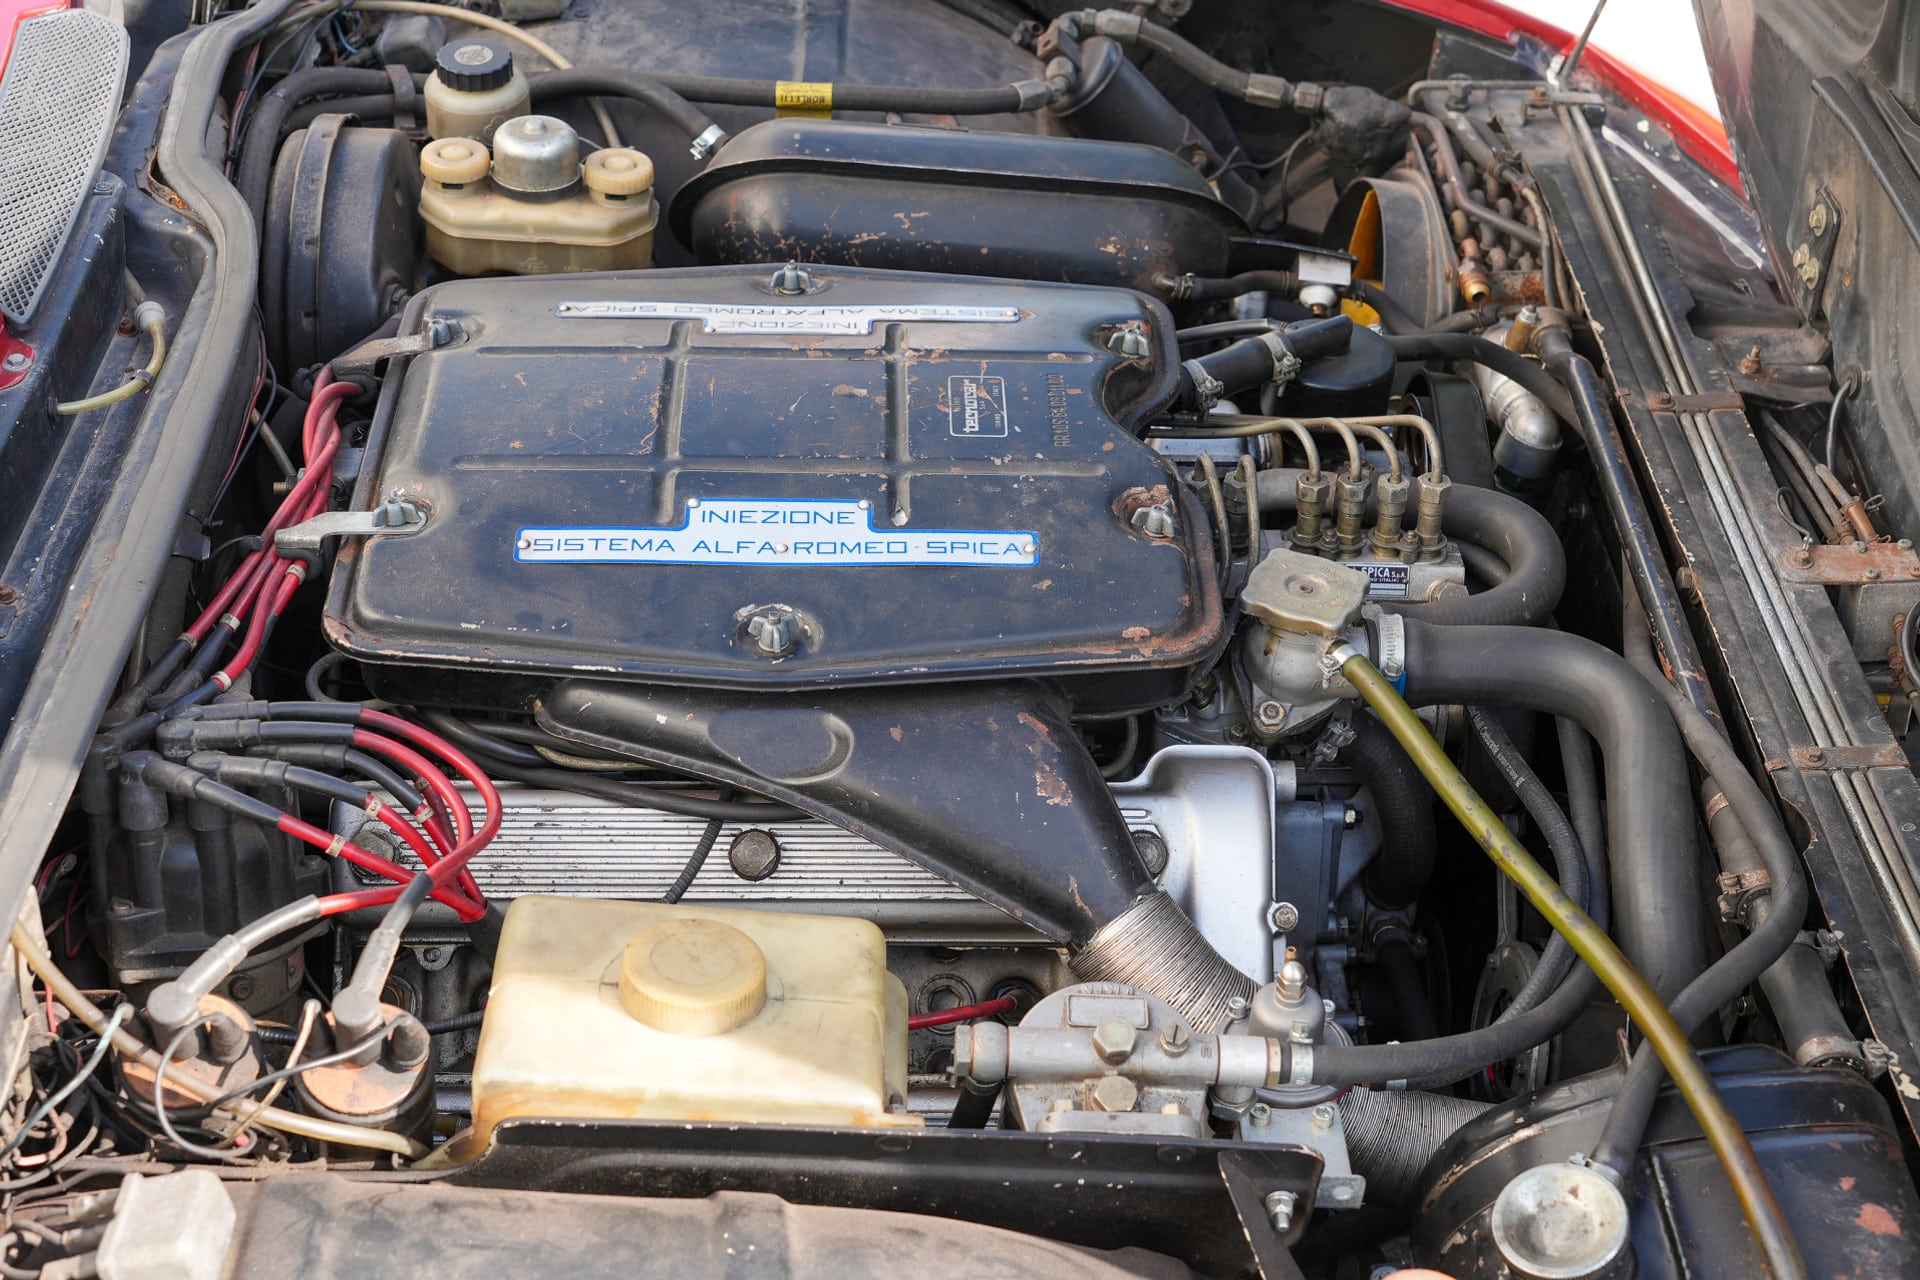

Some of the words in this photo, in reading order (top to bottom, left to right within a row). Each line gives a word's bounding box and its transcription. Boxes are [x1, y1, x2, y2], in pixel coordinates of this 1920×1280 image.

[780, 95, 825, 103] BORLETTI
[674, 306, 775, 315] ROMEO
[788, 308, 864, 316] ALFA
[880, 308, 1004, 317] SISTEMA
[718, 320, 857, 329] INIEZIONE
[963, 379, 979, 433] tecnocar
[702, 510, 856, 525] INIEZIONE
[533, 538, 675, 552] SISTEMA
[692, 540, 778, 555] ALFA
[793, 541, 908, 555] ROMEO
[926, 541, 1022, 555] SPICA
[1361, 567, 1390, 577] SPICA
